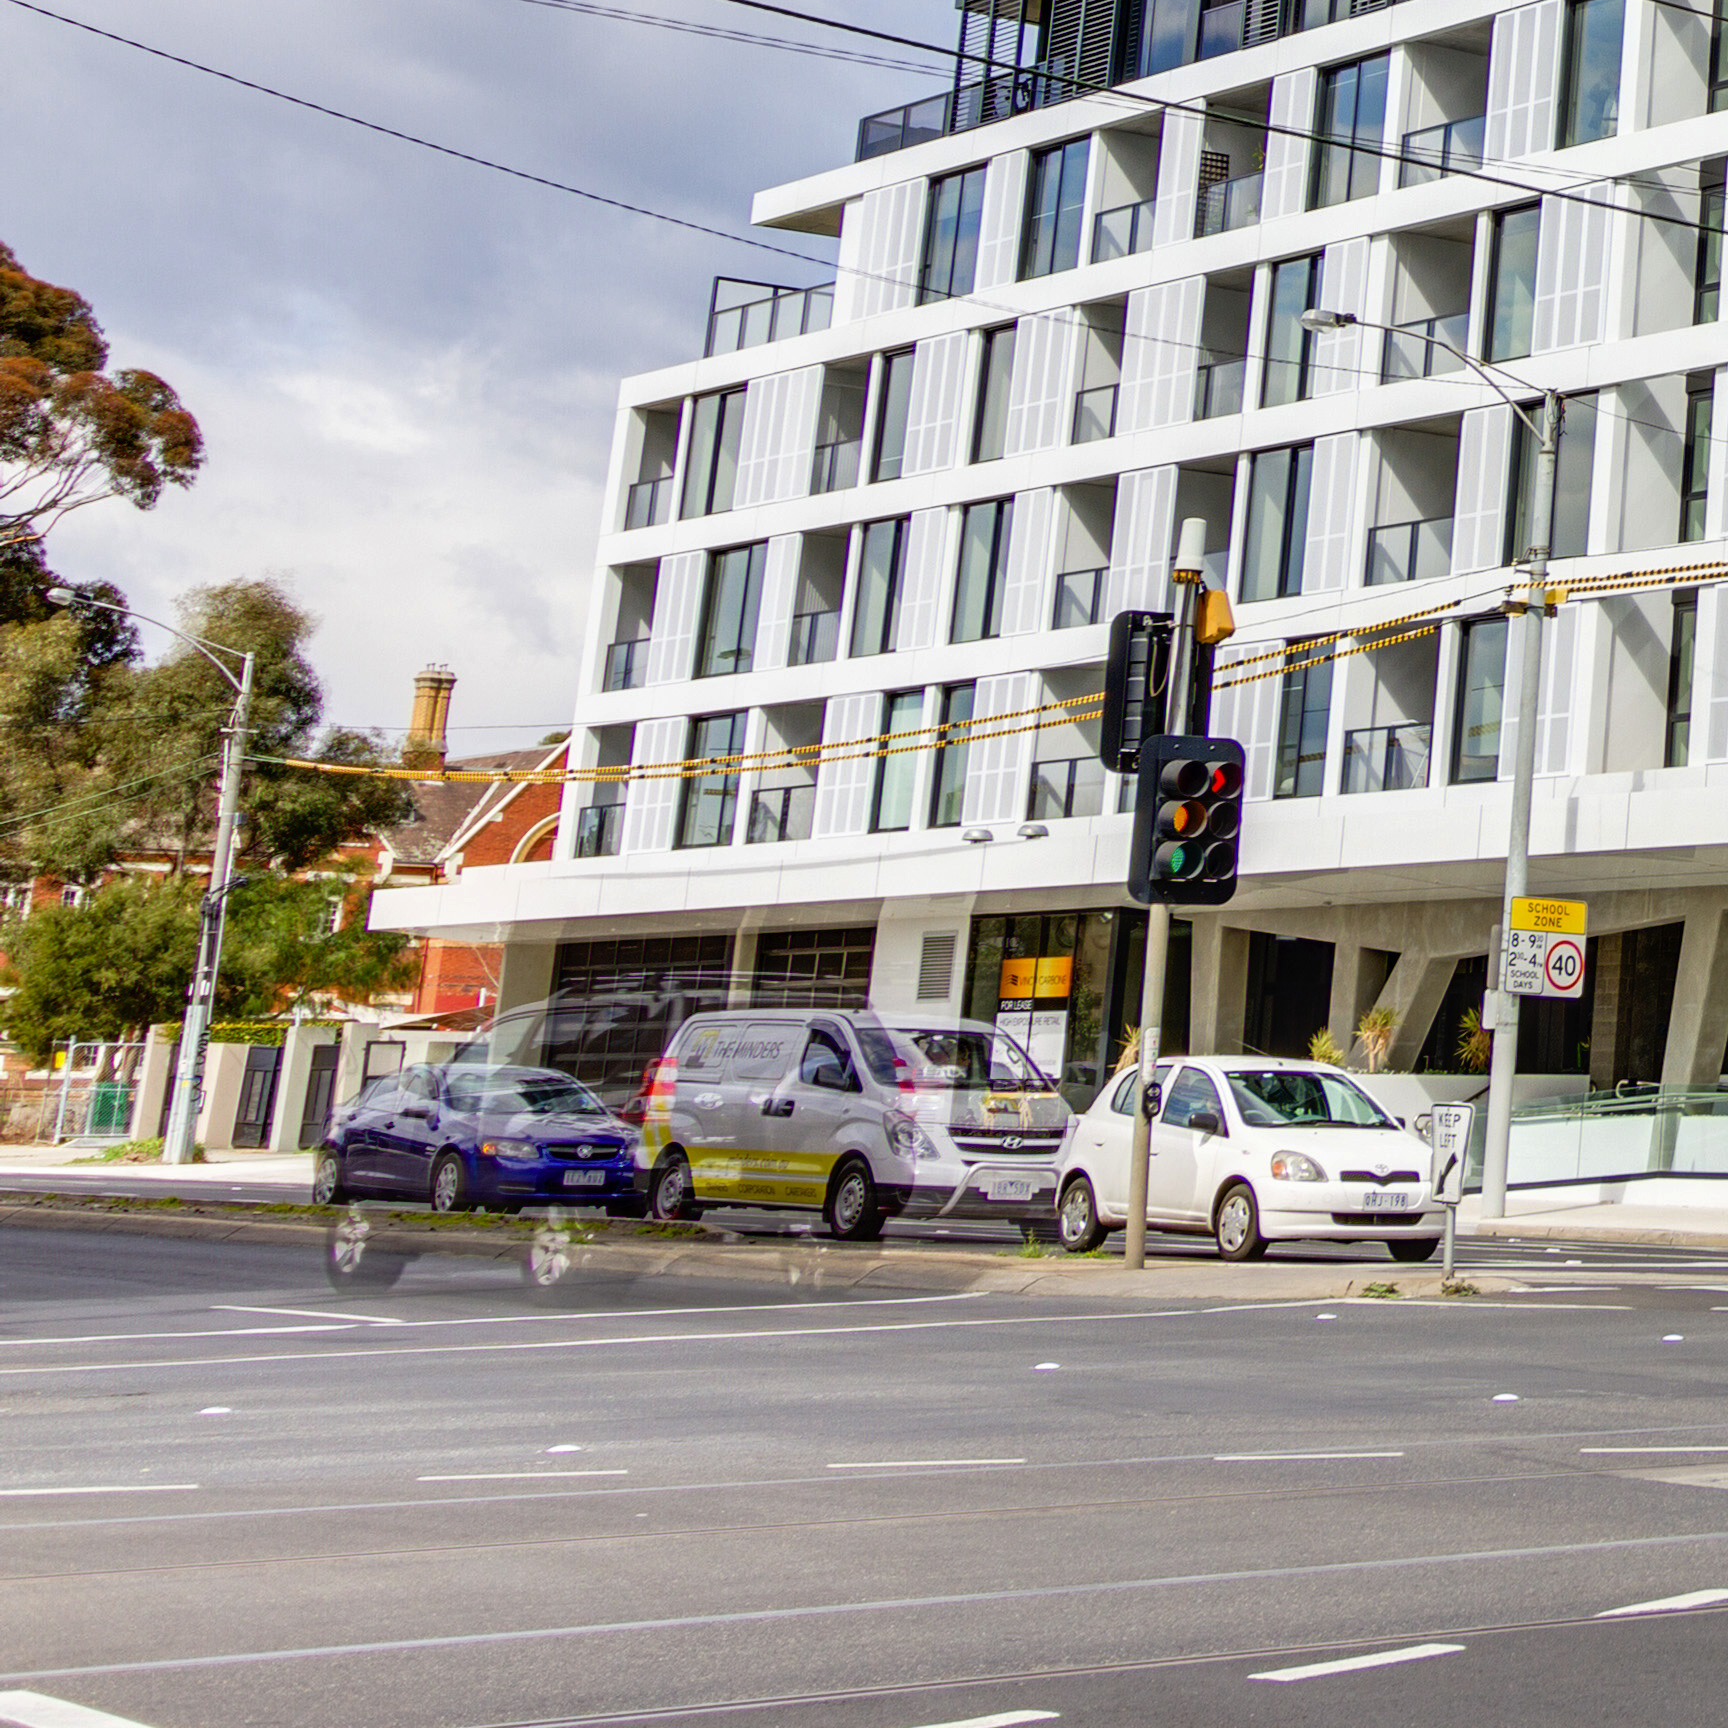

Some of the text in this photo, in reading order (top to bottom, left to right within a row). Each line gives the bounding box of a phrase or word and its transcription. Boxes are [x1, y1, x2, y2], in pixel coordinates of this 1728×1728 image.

[1528, 902, 1570, 916] SCHOOL
[1533, 915, 1563, 928] ZONE
[1551, 954, 1576, 977] 40
[1510, 969, 1539, 980] SCHOOL
[1513, 980, 1533, 990] DAYS
[1001, 999, 1033, 1010] FOR LEASE
[733, 1040, 785, 1060] MINDERS
[1439, 1113, 1461, 1128] KEEP
[1439, 1133, 1457, 1148] LEFT
